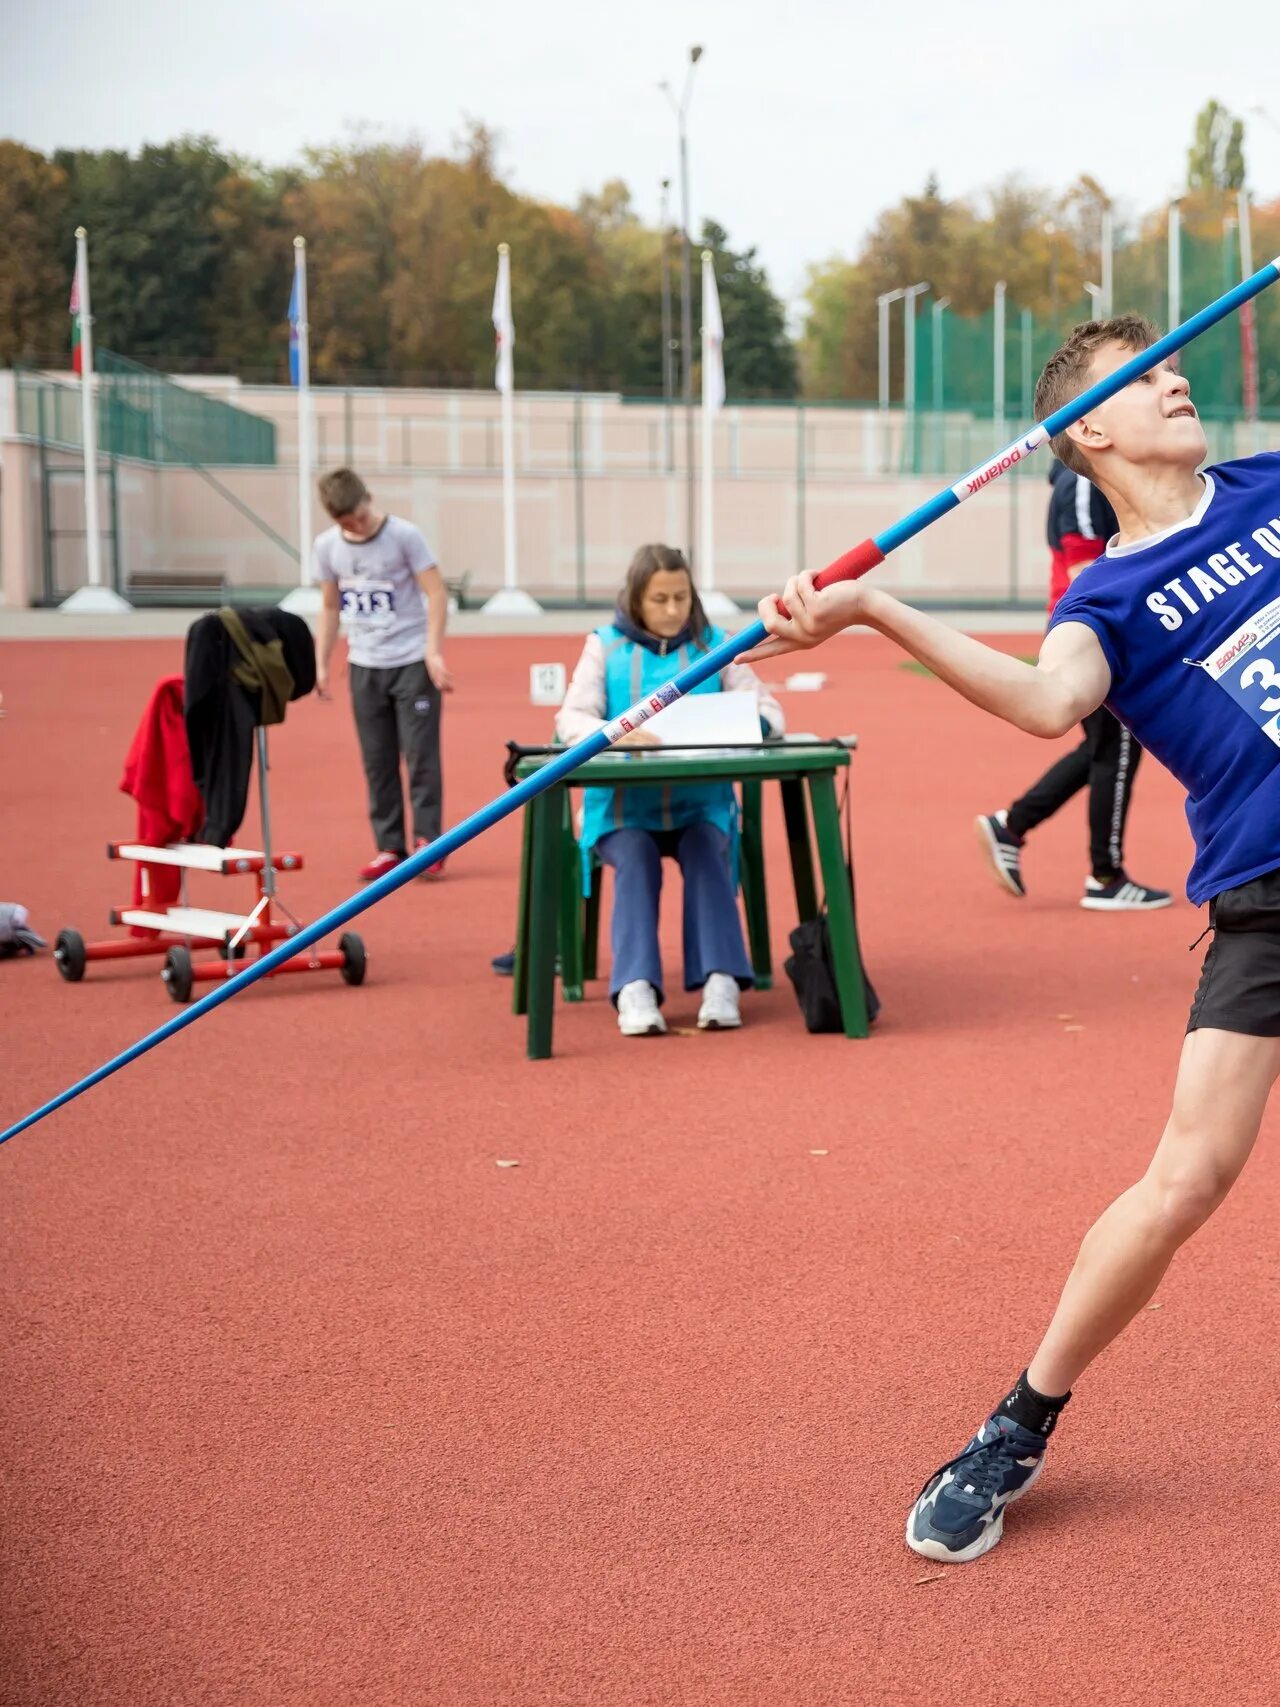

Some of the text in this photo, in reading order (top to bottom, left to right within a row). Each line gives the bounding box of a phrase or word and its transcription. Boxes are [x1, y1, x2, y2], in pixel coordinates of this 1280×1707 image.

[966, 447, 1021, 493] polanik
[343, 591, 391, 615] 313
[1146, 542, 1263, 631] STAGE
